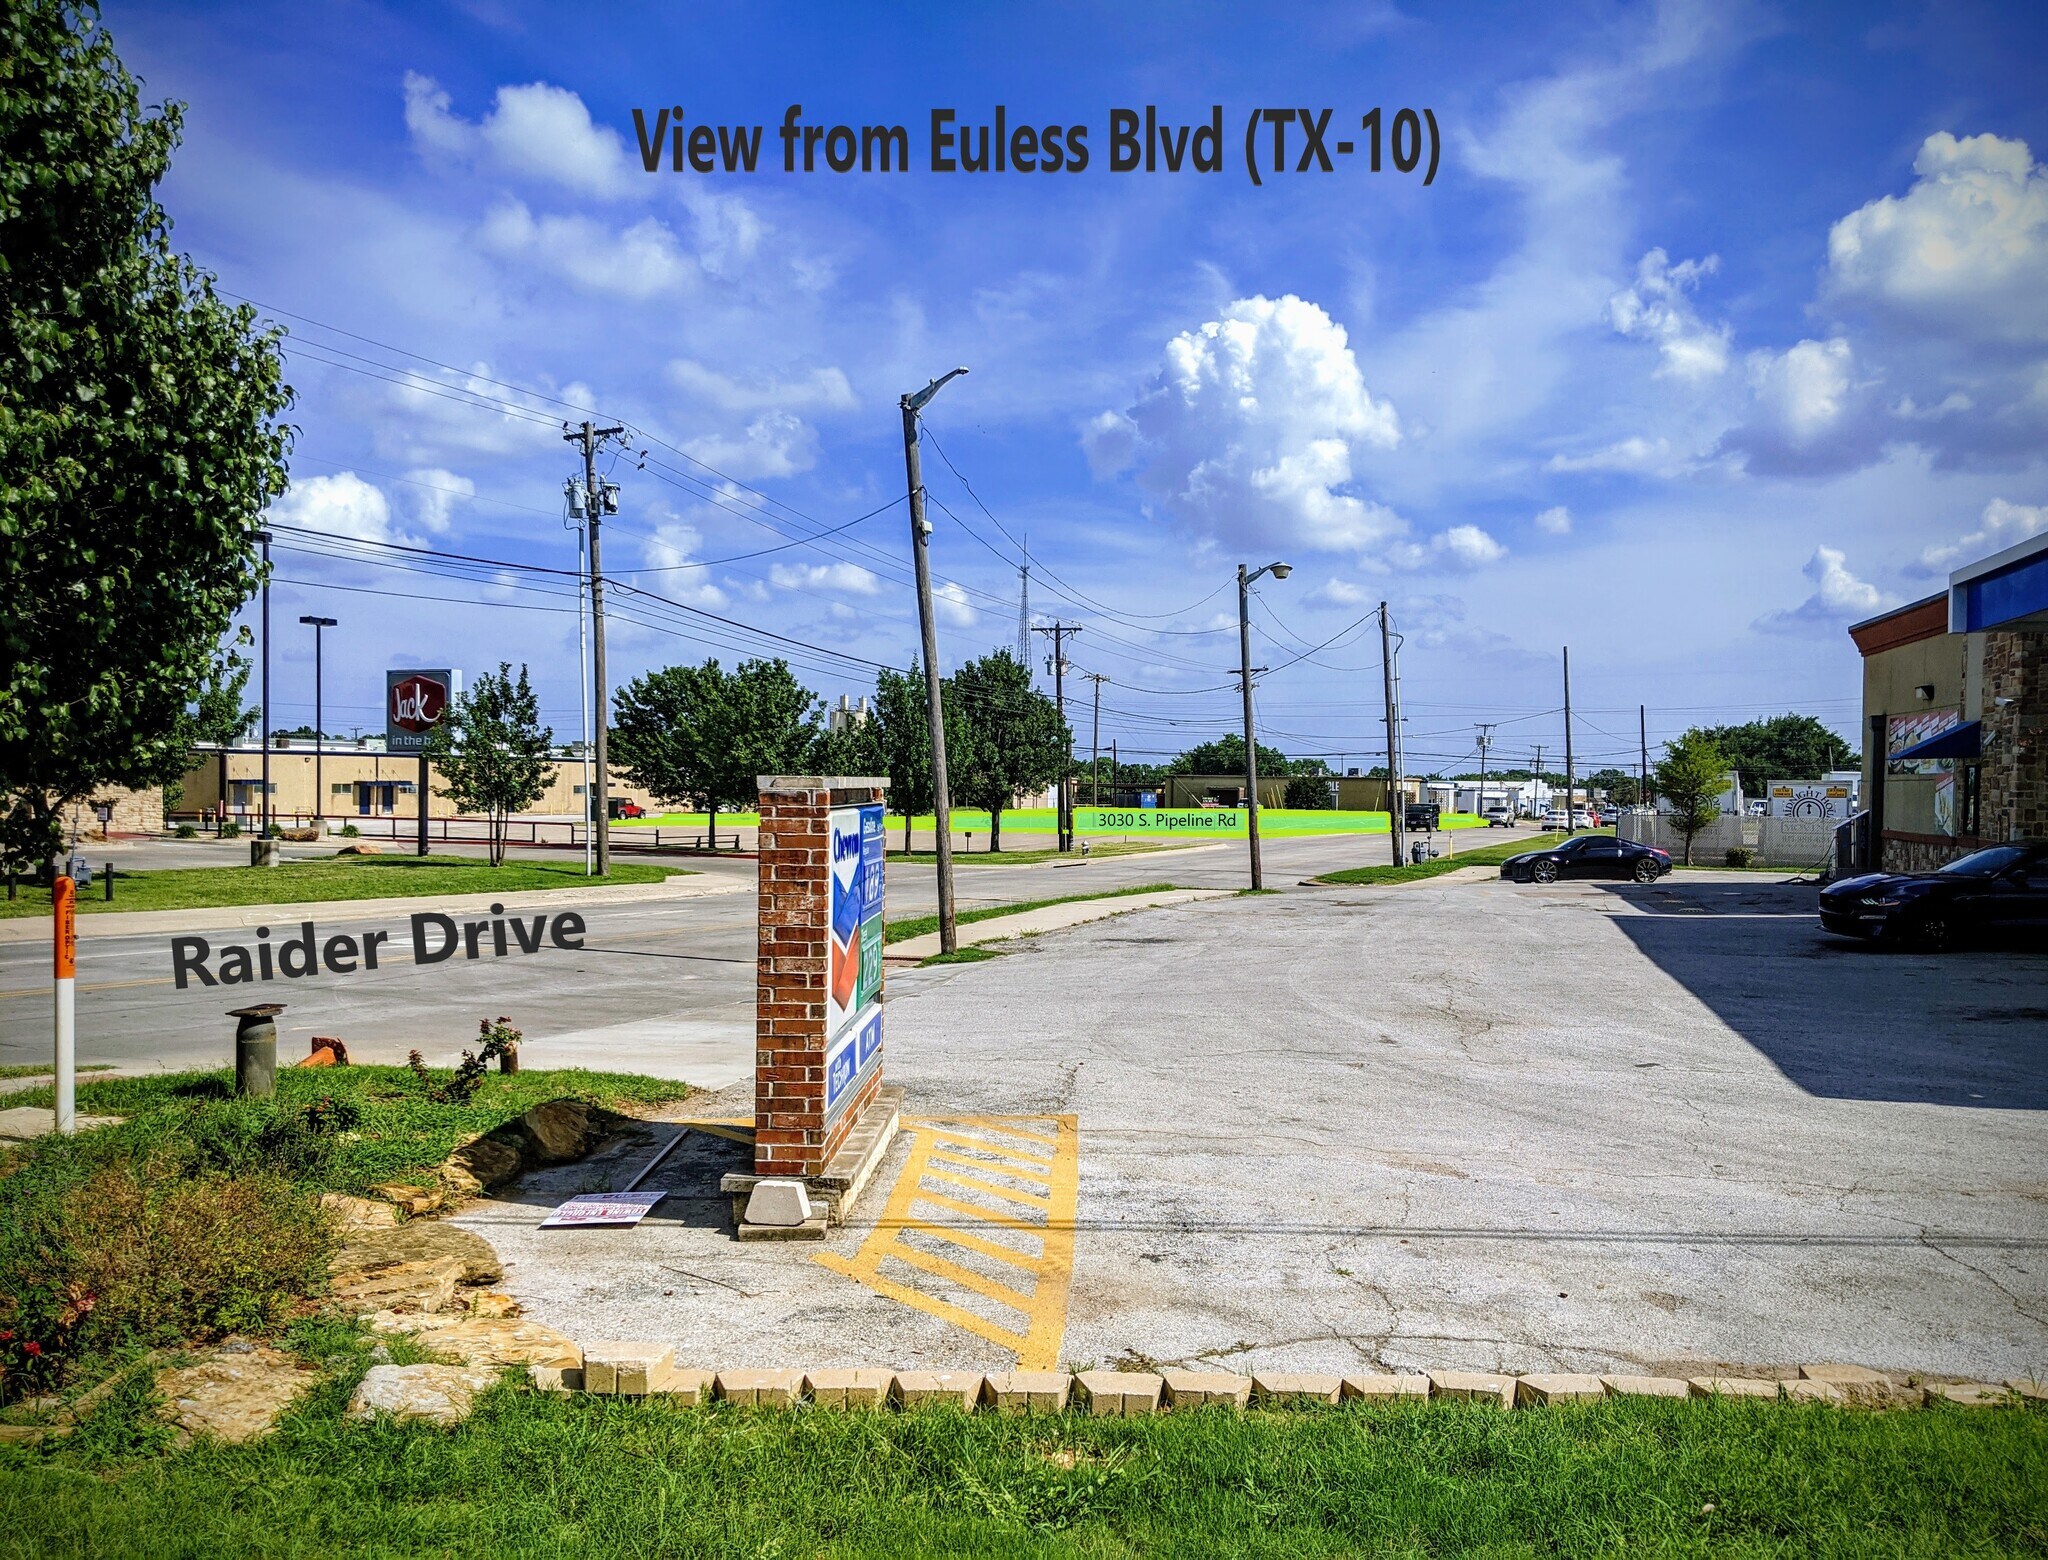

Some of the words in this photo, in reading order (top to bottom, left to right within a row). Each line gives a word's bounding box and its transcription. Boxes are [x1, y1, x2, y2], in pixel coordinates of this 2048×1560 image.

[392, 683, 442, 723] Jack
[392, 735, 402, 746] in
[403, 735, 422, 746] the
[833, 827, 859, 864] Chevron
[865, 1022, 876, 1054] ATM
